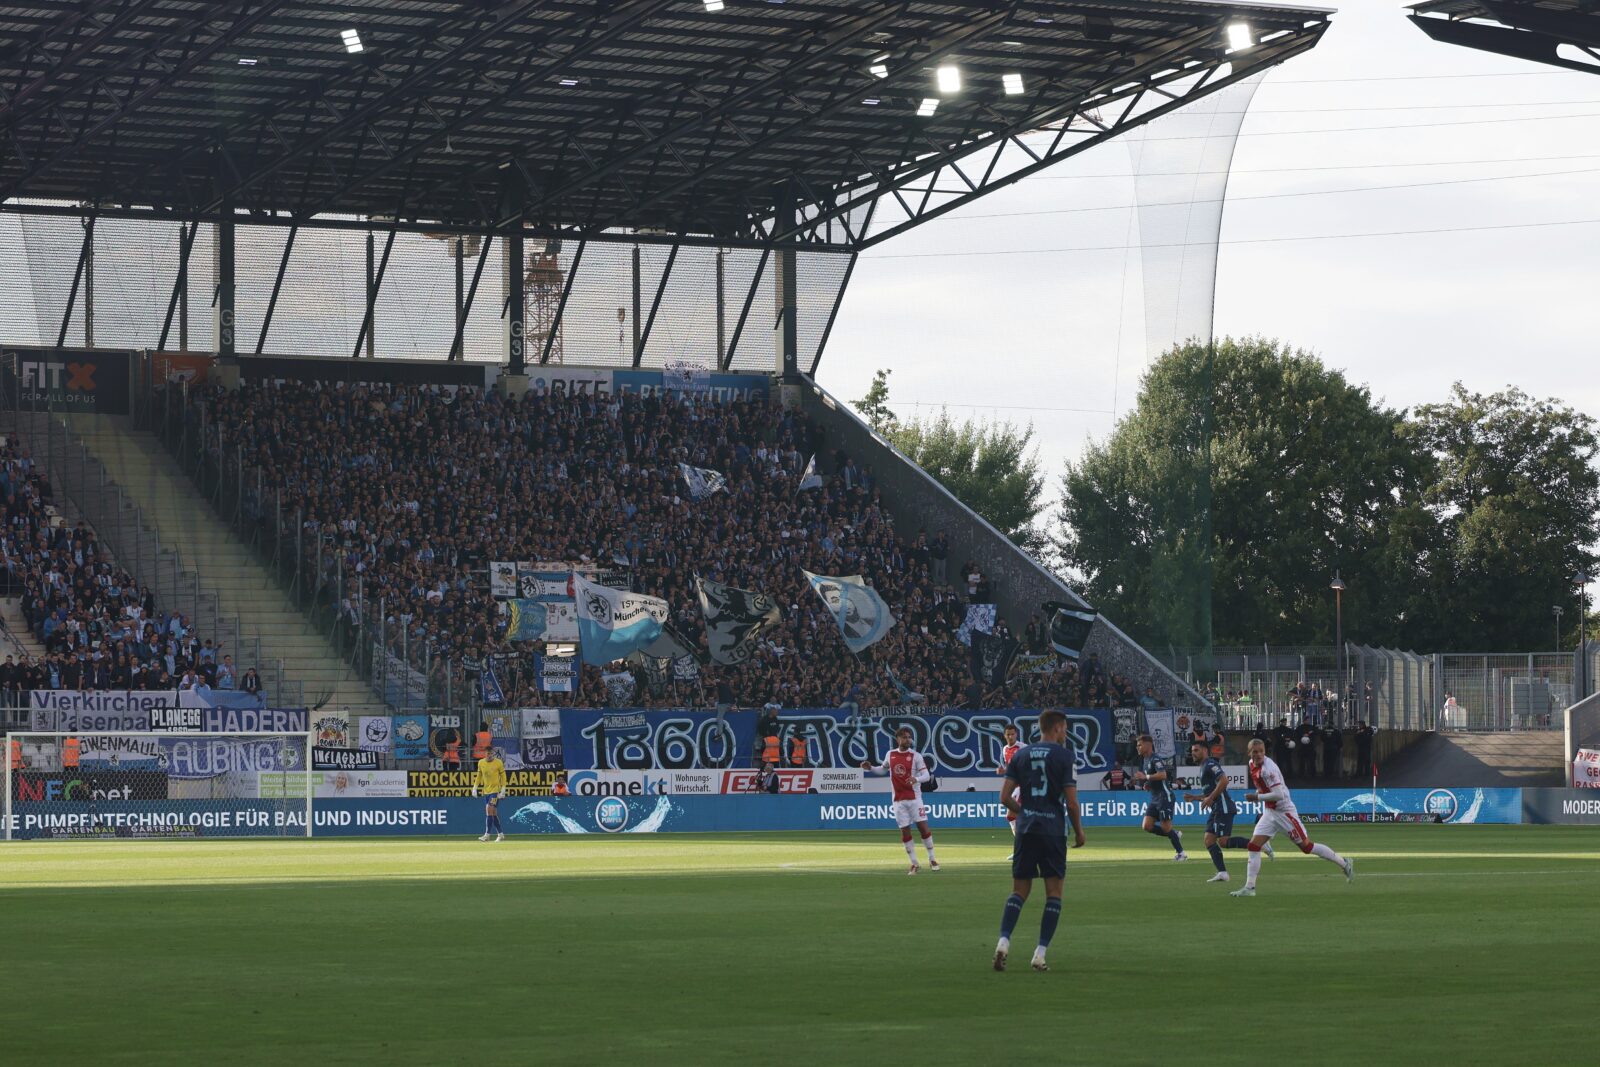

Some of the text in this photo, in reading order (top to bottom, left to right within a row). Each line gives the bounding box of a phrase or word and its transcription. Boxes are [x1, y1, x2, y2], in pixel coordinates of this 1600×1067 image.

[66, 394, 81, 403] OF
[84, 395, 96, 404] US
[34, 691, 168, 712] Vierkirchen
[152, 709, 201, 726] PLANEGG
[206, 710, 306, 732] HADERN
[430, 714, 461, 728] MIB
[581, 714, 737, 771] 1860
[173, 740, 276, 777] AUBING
[314, 750, 376, 765] INFLAGRANTI
[358, 779, 370, 787] fgn
[675, 774, 712, 783] Wohnungs-
[822, 773, 860, 781] SCHWERLAST-
[1031, 760, 1048, 797] 3
[675, 784, 711, 792] Wirtschaft.
[820, 783, 862, 791] NUTZFAHRZEUGE
[1098, 799, 1126, 817] FÜR
[1130, 802, 1149, 817] BA
[1174, 801, 1195, 817] ND
[1429, 796, 1452, 809] SPT
[602, 803, 623, 816] SPT
[236, 808, 269, 827] FÜR
[275, 810, 307, 828] BAU
[315, 810, 350, 826] UND
[357, 809, 447, 826] INDUSTRIE
[52, 826, 116, 834] GARTENBAU
[131, 825, 194, 833] GARTENBAU
